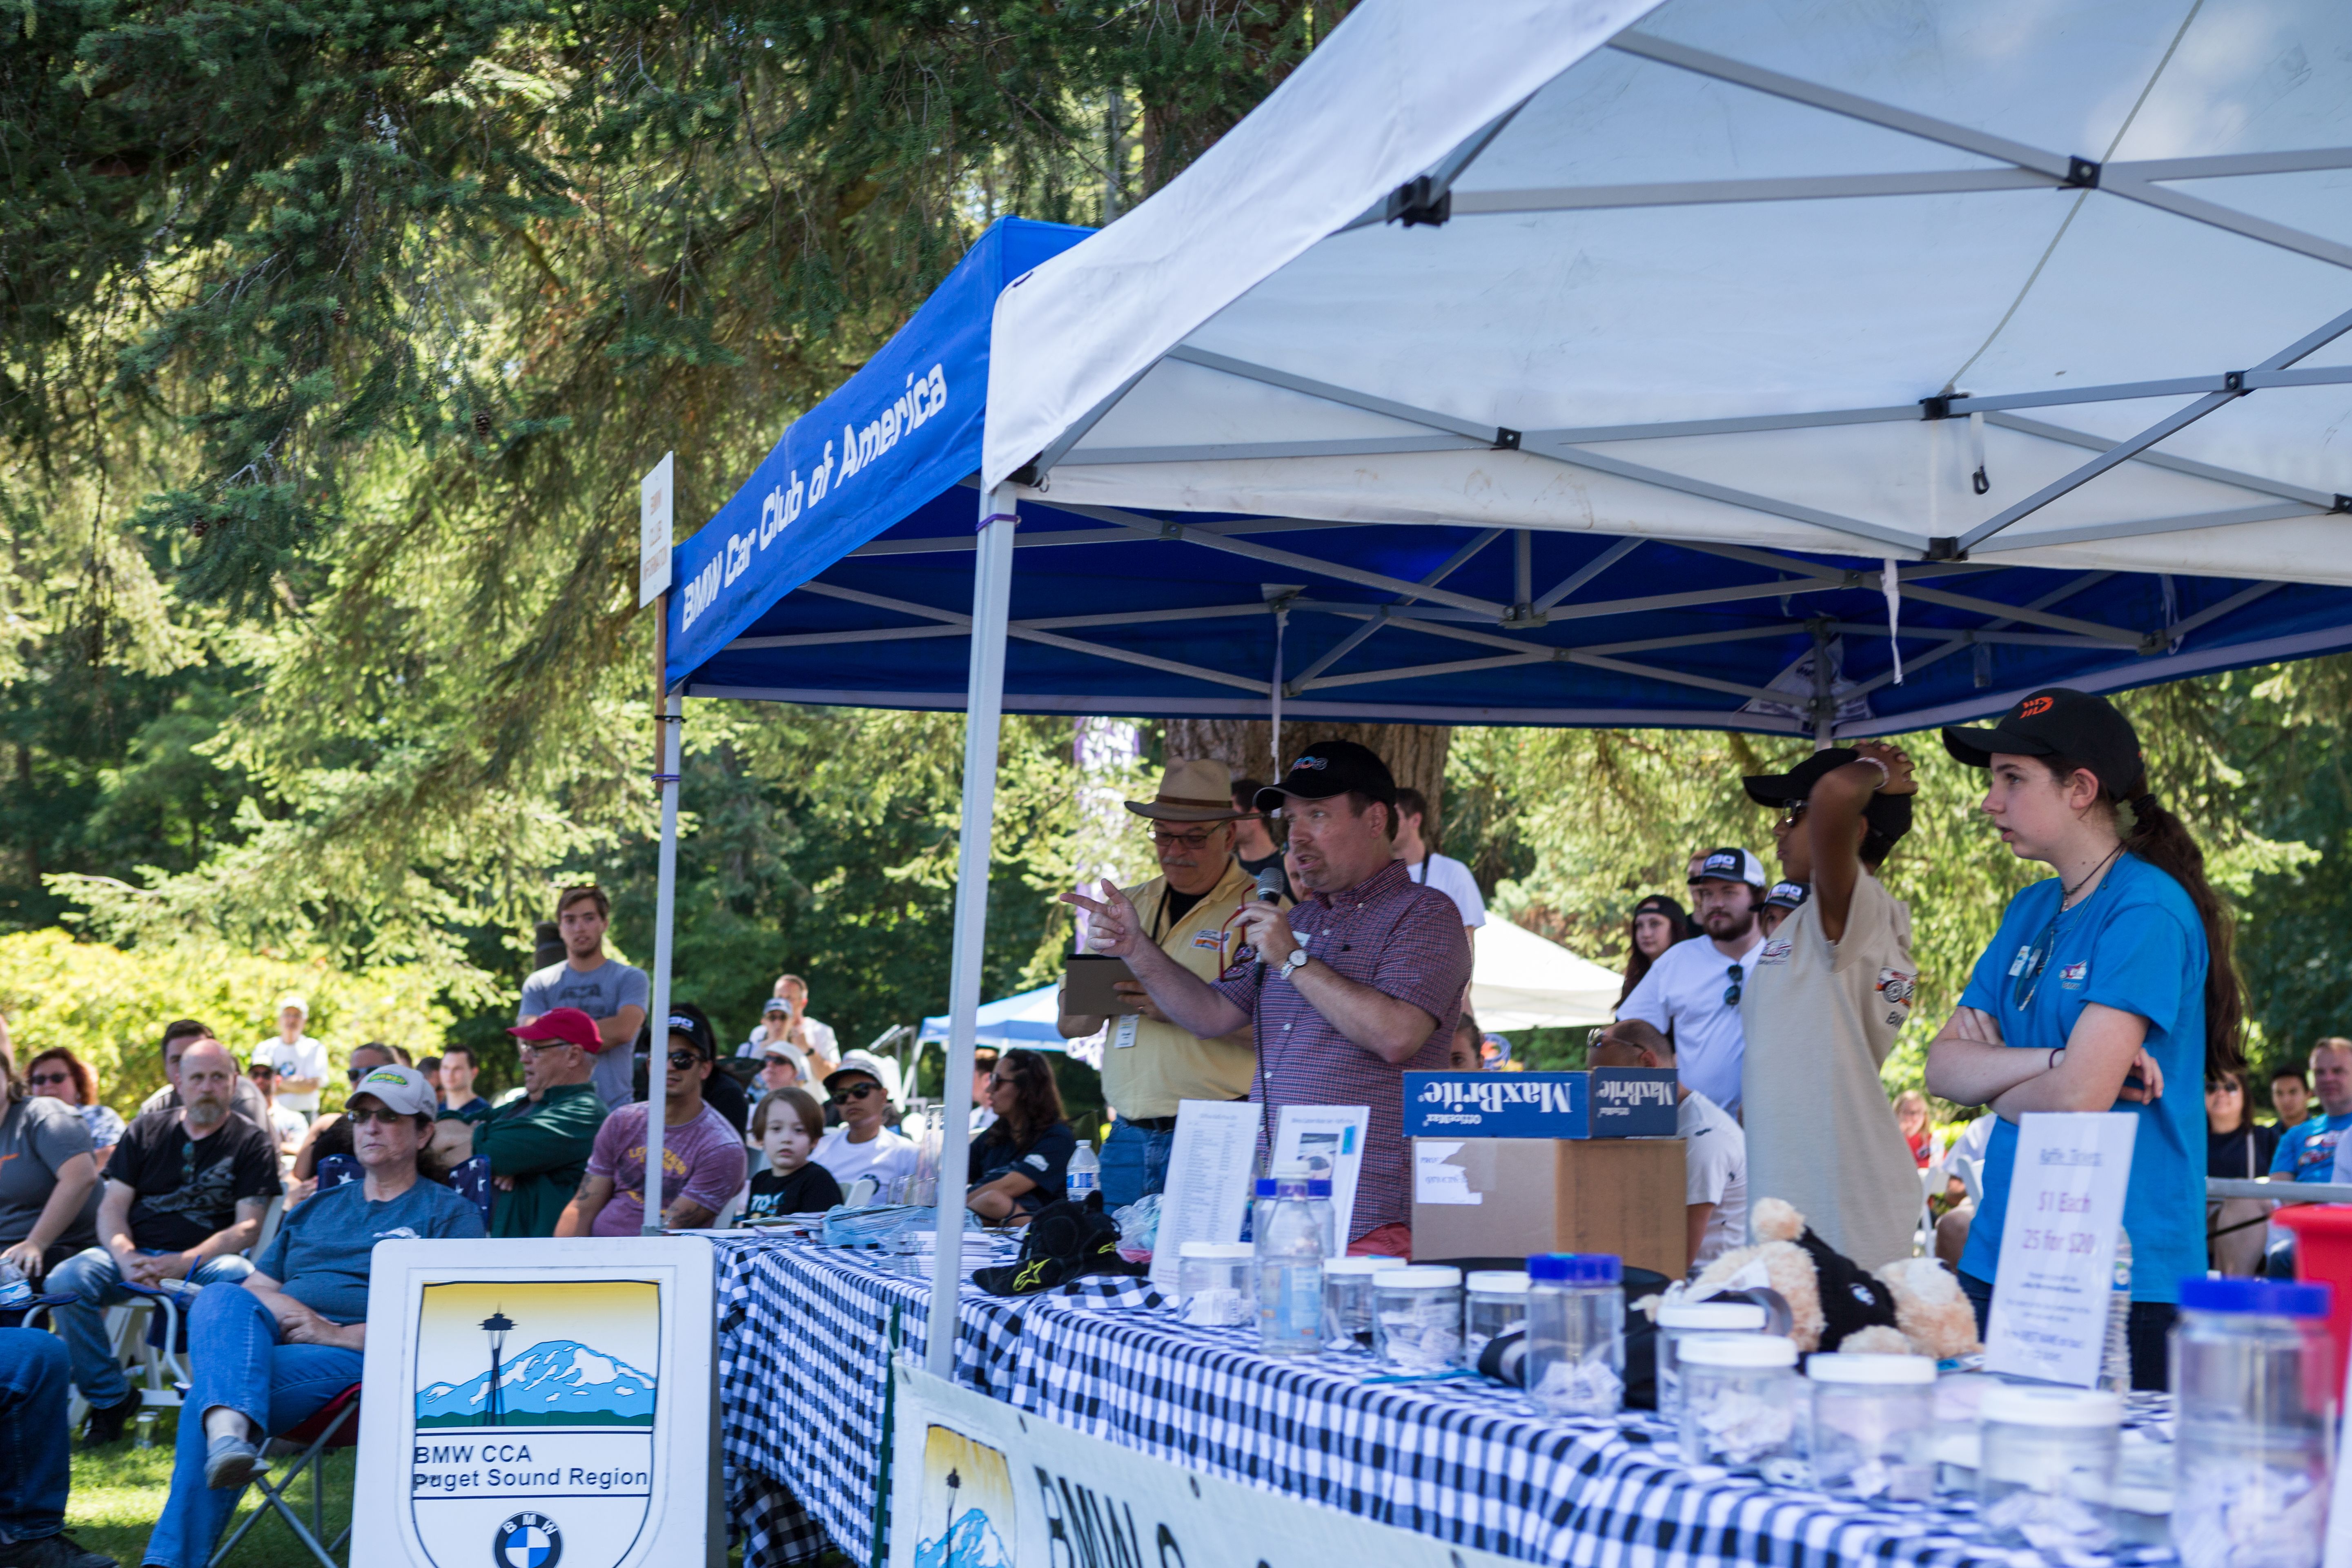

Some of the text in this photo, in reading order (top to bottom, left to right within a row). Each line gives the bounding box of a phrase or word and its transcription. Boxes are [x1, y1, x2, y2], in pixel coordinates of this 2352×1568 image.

[682, 363, 947, 634] BMW Car Club of America
[1423, 1082, 1572, 1113] MaxBrite
[1596, 1080, 1675, 1106] MaxBrite
[413, 1445, 532, 1464] BMW CCA
[412, 1468, 648, 1492] Puget Sound Region
[503, 1513, 559, 1535] BMW
